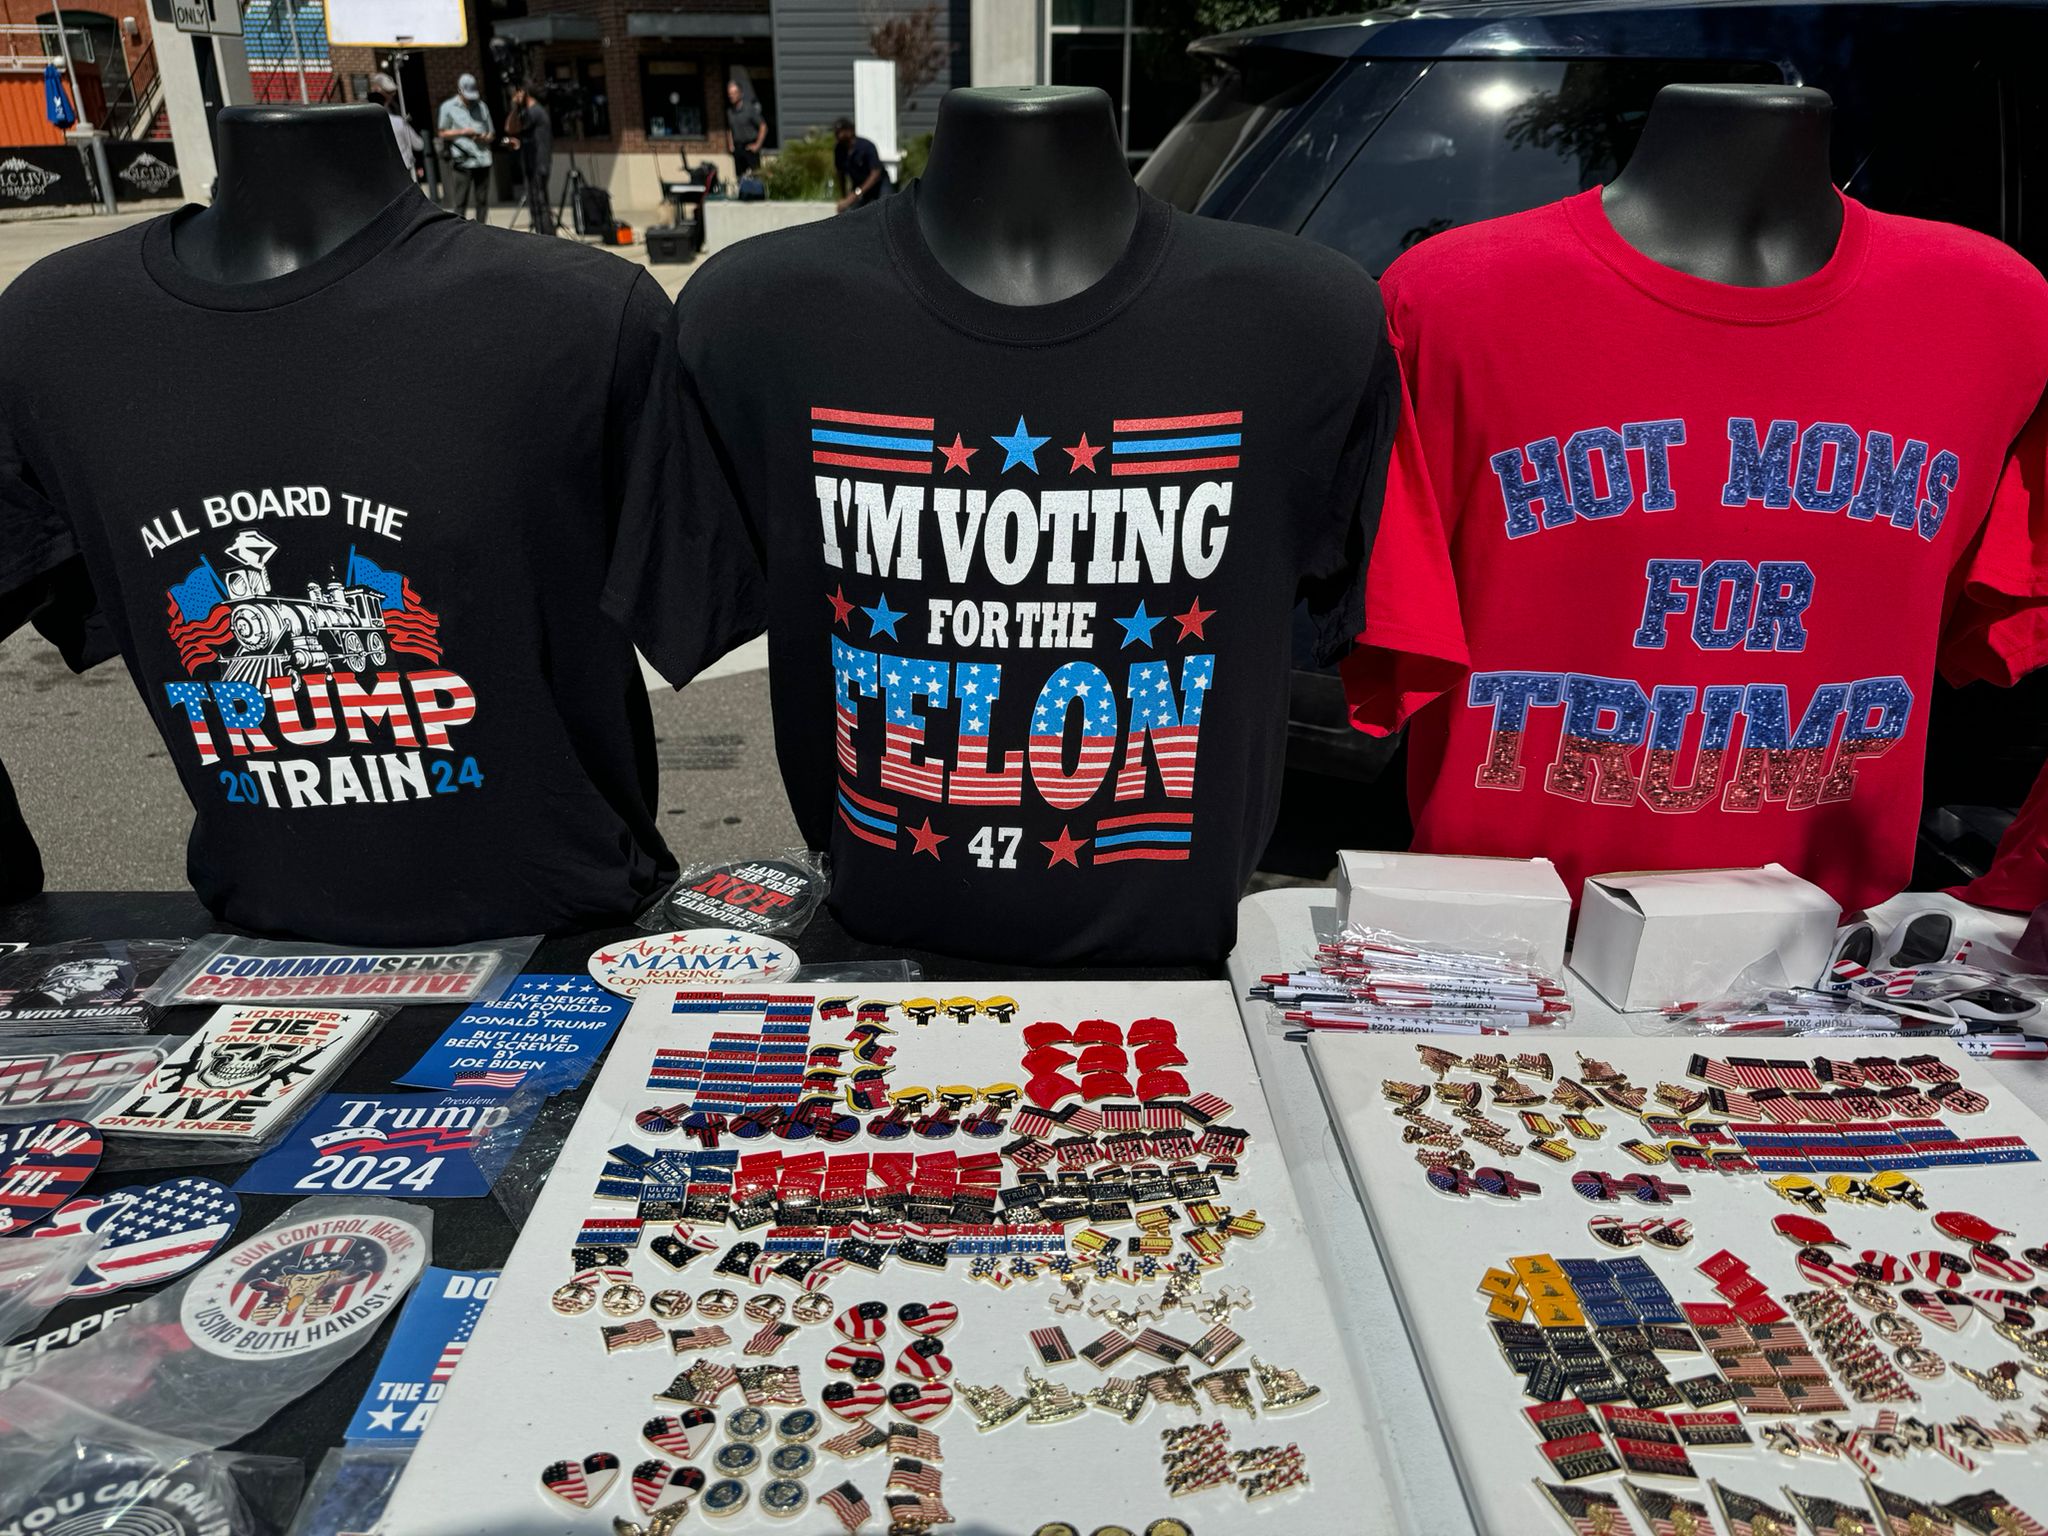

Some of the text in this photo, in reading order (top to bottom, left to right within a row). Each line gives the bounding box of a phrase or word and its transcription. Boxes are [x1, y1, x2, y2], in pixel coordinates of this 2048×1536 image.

[177, 7, 205, 24] ONLY
[1490, 417, 1960, 543] HOT MOMS
[140, 486, 409, 557] ALL BOARD THE
[814, 475, 1233, 585] I'M VOTING
[1632, 558, 1817, 653] FOR
[927, 598, 1097, 649] FOR THE
[164, 669, 477, 766] TRUMP
[831, 632, 1216, 810] FELON
[1467, 671, 1914, 815] TRUMP
[246, 751, 432, 808] TRAIN
[431, 756, 485, 794] 24
[967, 826, 1023, 869] 47
[731, 868, 801, 897] THE FREE
[745, 863, 808, 888] LAND OF
[691, 873, 795, 915] NOT
[676, 888, 705, 903] LAND
[703, 897, 722, 906] OF
[719, 902, 744, 915] THE
[672, 896, 753, 928] HANDOUTS
[623, 940, 771, 957] American
[618, 953, 759, 970] MAMA
[646, 969, 722, 978] RAISING
[184, 975, 478, 997] CONSERVATIVE
[509, 993, 600, 1005] I'VE NEVER
[16, 1008, 71, 1019] WITH
[73, 1006, 144, 1018] TRUMP
[483, 1001, 612, 1014] BEEN FONDLED
[270, 1010, 340, 1021] RATHER
[527, 1011, 554, 1019] BY
[250, 1019, 317, 1036] DIE
[461, 1016, 607, 1030] DONALD TRUMP
[1371, 1023, 1395, 1032] 2024
[1787, 1019, 1811, 1027] 2024
[214, 1035, 326, 1046] ON MY FEET
[472, 1031, 573, 1043] BUT I HAVE
[444, 1039, 580, 1053] BEEN SCREWED
[493, 1051, 521, 1059] BY
[449, 1058, 547, 1070] JOE BIDEN
[1873, 1068, 1905, 1081] 24
[1919, 1066, 1950, 1079] 24
[180, 1086, 252, 1099] THAN
[118, 1095, 272, 1121] LIVE
[439, 1096, 496, 1106] President
[1850, 1100, 1882, 1113] 24
[1901, 1099, 1932, 1111] 24
[98, 1117, 256, 1132] ON MY KNEES
[332, 1100, 510, 1137] Trump
[1114, 1144, 1143, 1157] 24
[1161, 1142, 1191, 1154] 24
[1207, 1137, 1236, 1151] 24
[1020, 1144, 1047, 1160] 24
[1065, 1147, 1094, 1160] 24
[294, 1155, 445, 1191] 2024
[661, 1161, 682, 1181] ULTRA
[1135, 1184, 1170, 1194] TRUMP
[1180, 1180, 1213, 1191] TRUMP
[1006, 1187, 1038, 1200] TRUMP
[231, 1219, 414, 1267] GUN CONTROL MEANS
[1611, 1260, 1641, 1268] ULTRA
[1580, 1282, 1610, 1290] ULTRA
[1632, 1290, 1663, 1298] MAGA
[194, 1294, 392, 1351] USING BOTH HANDS!
[1535, 1364, 1552, 1397] TRUMP
[377, 1382, 425, 1400] THE
[1613, 1407, 1659, 1421] FUCK
[1684, 1413, 1730, 1424] FUCK
[1549, 1420, 1596, 1439] BIDEN
[1690, 1430, 1741, 1441] BIDEN
[1629, 1441, 1674, 1455] FUCK
[1565, 1455, 1613, 1477] BIDEN
[0, 1491, 85, 1536] YOU
[94, 1478, 171, 1503] CAN
